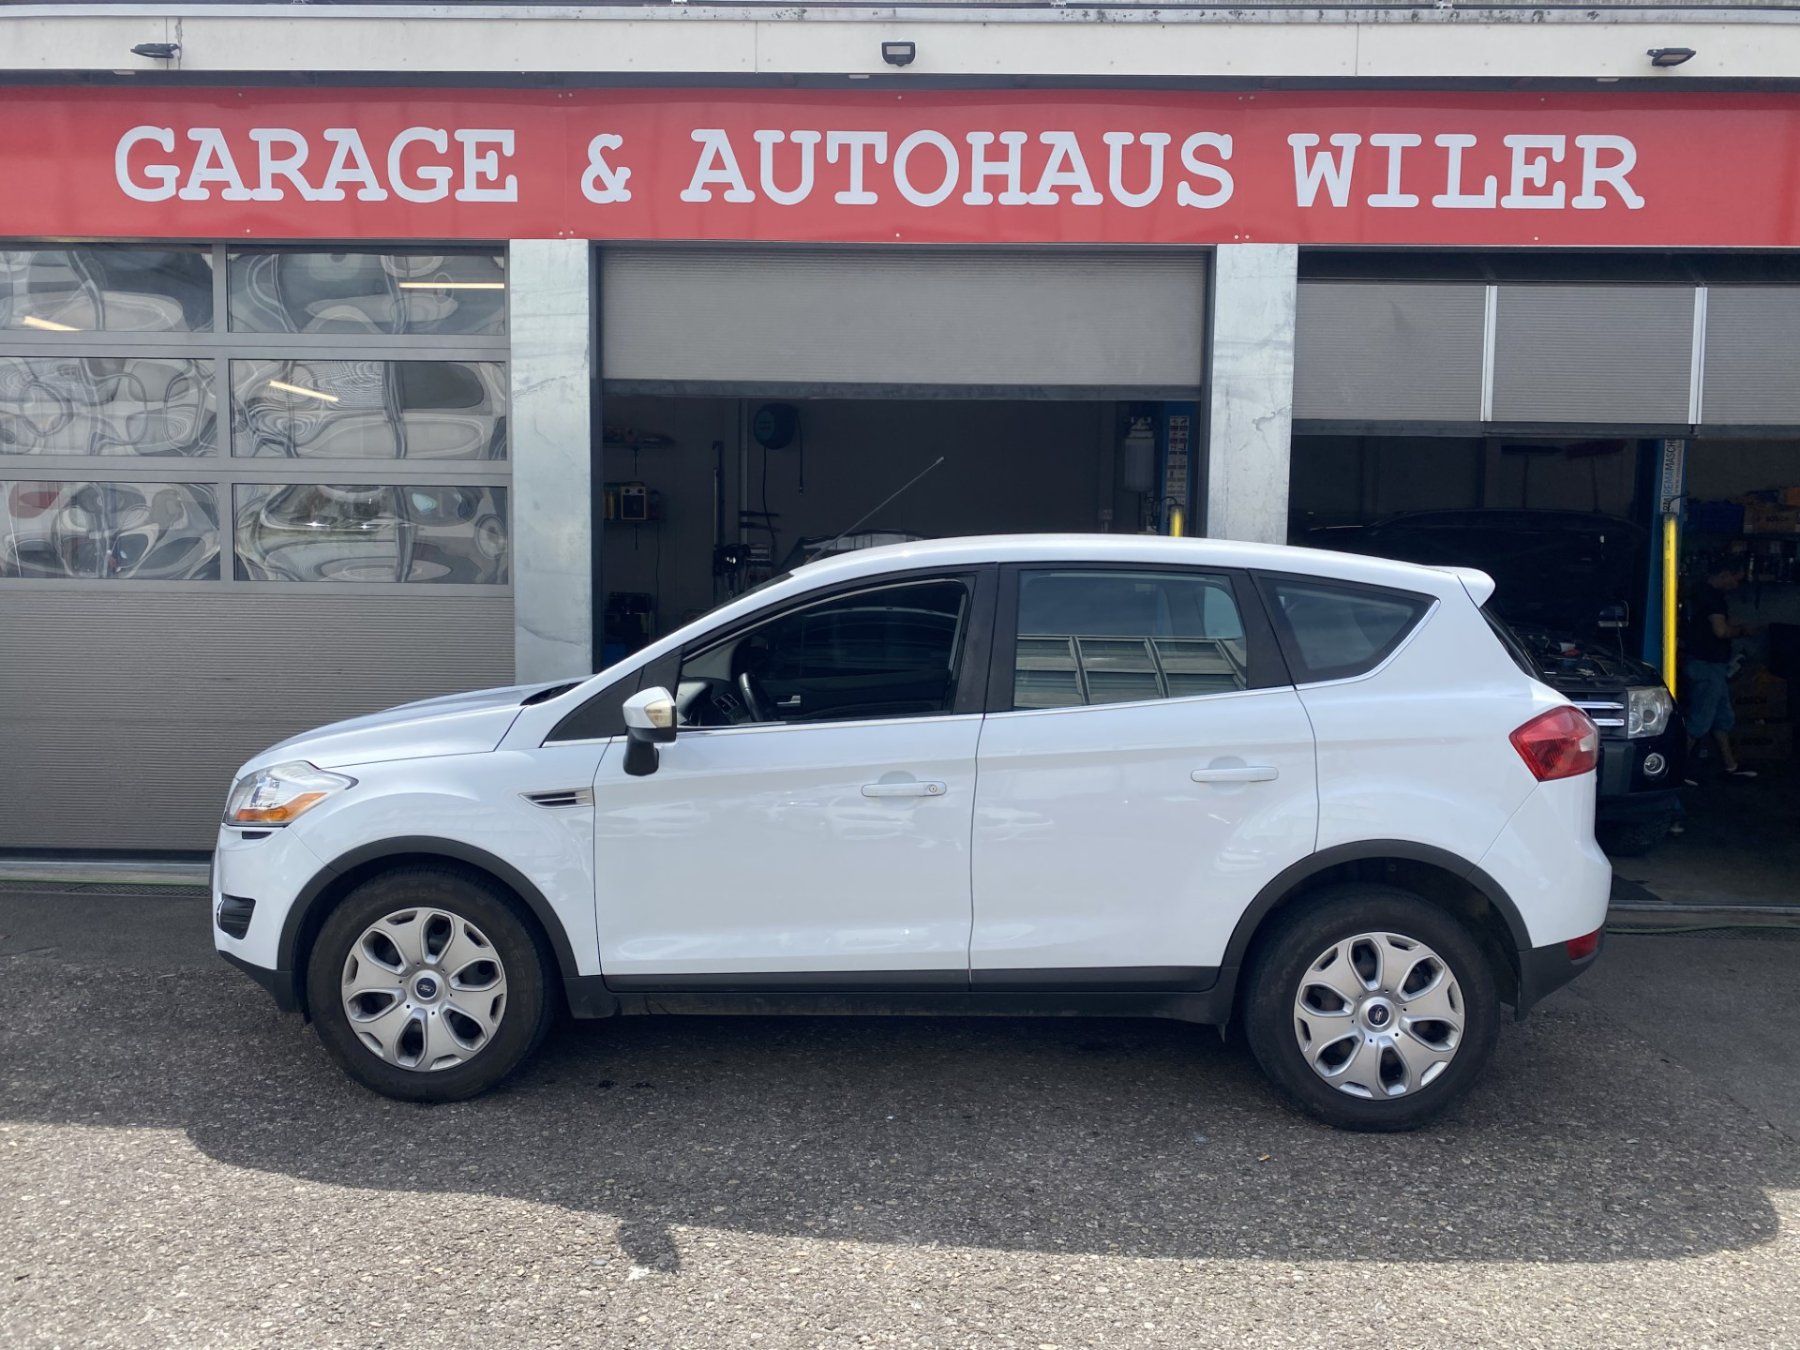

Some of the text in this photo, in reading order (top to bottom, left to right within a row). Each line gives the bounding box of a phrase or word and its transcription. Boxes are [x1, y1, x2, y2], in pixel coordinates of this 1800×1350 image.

[114, 125, 1646, 210] GARAGE & AUTOHAUS WILER
